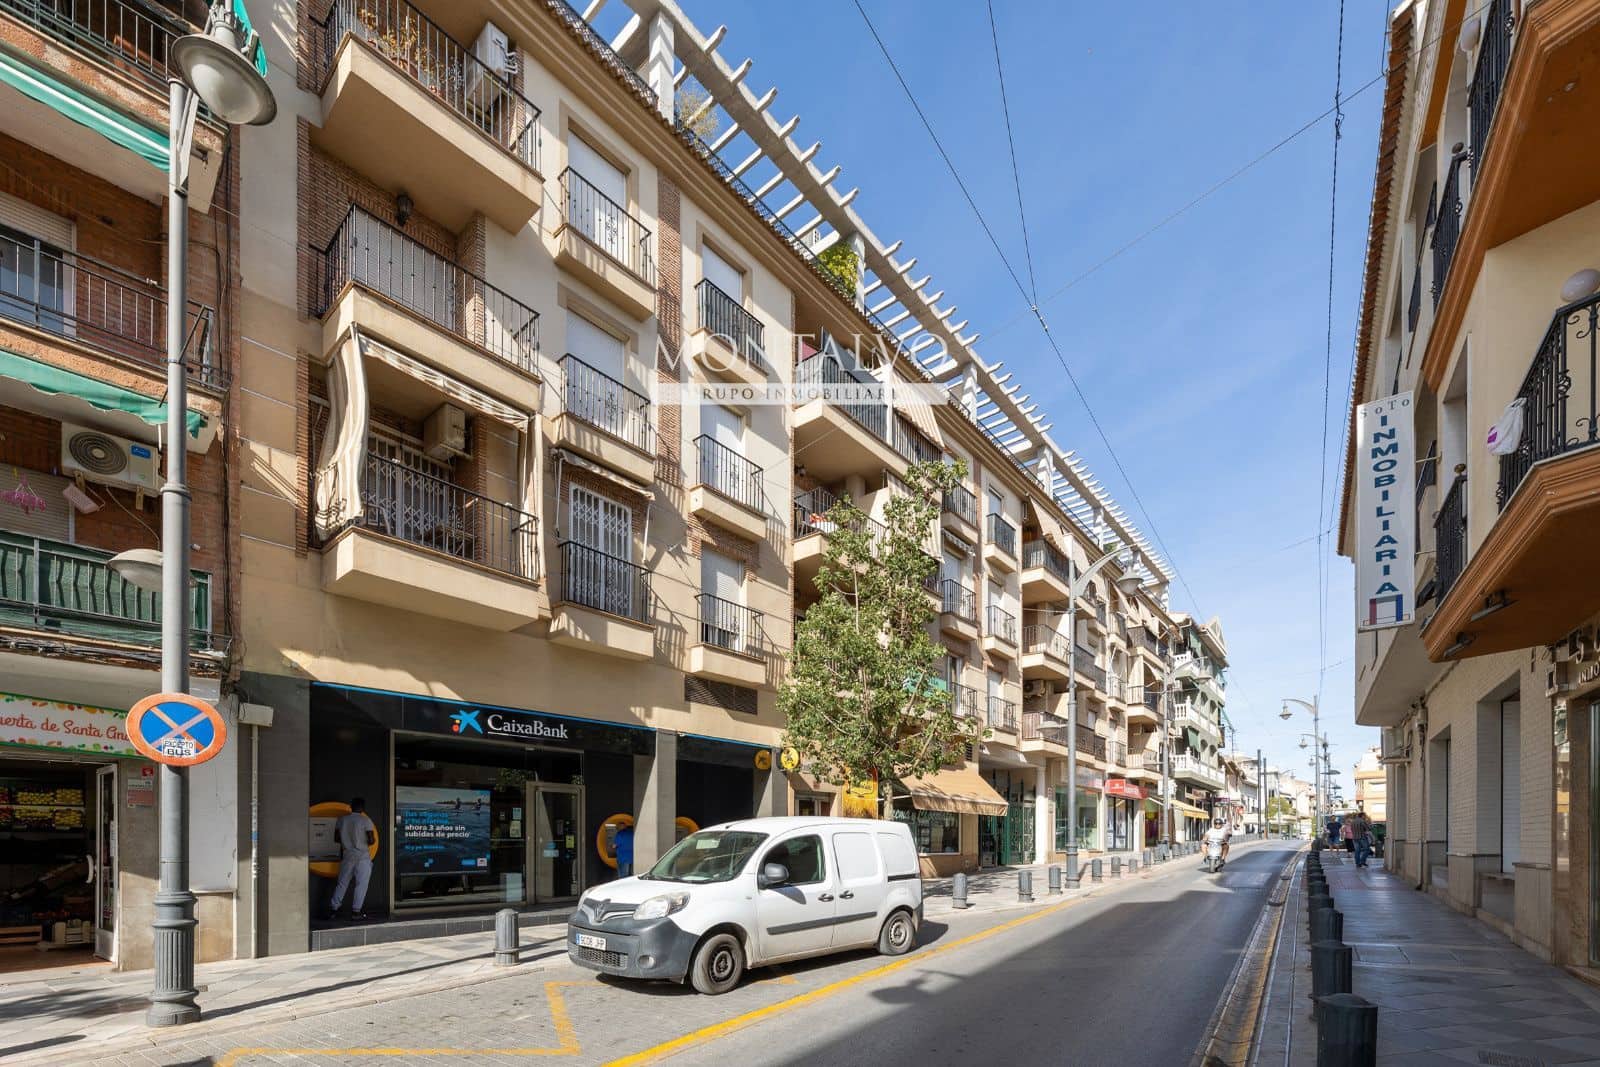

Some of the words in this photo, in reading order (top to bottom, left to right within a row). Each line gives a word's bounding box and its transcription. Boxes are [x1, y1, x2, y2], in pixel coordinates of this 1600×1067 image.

[1371, 415, 1399, 595] INMOBILIARIA
[41, 717, 60, 731] de
[63, 719, 103, 738] Santa
[487, 714, 568, 739] CaixaBank
[167, 748, 191, 756] BUS
